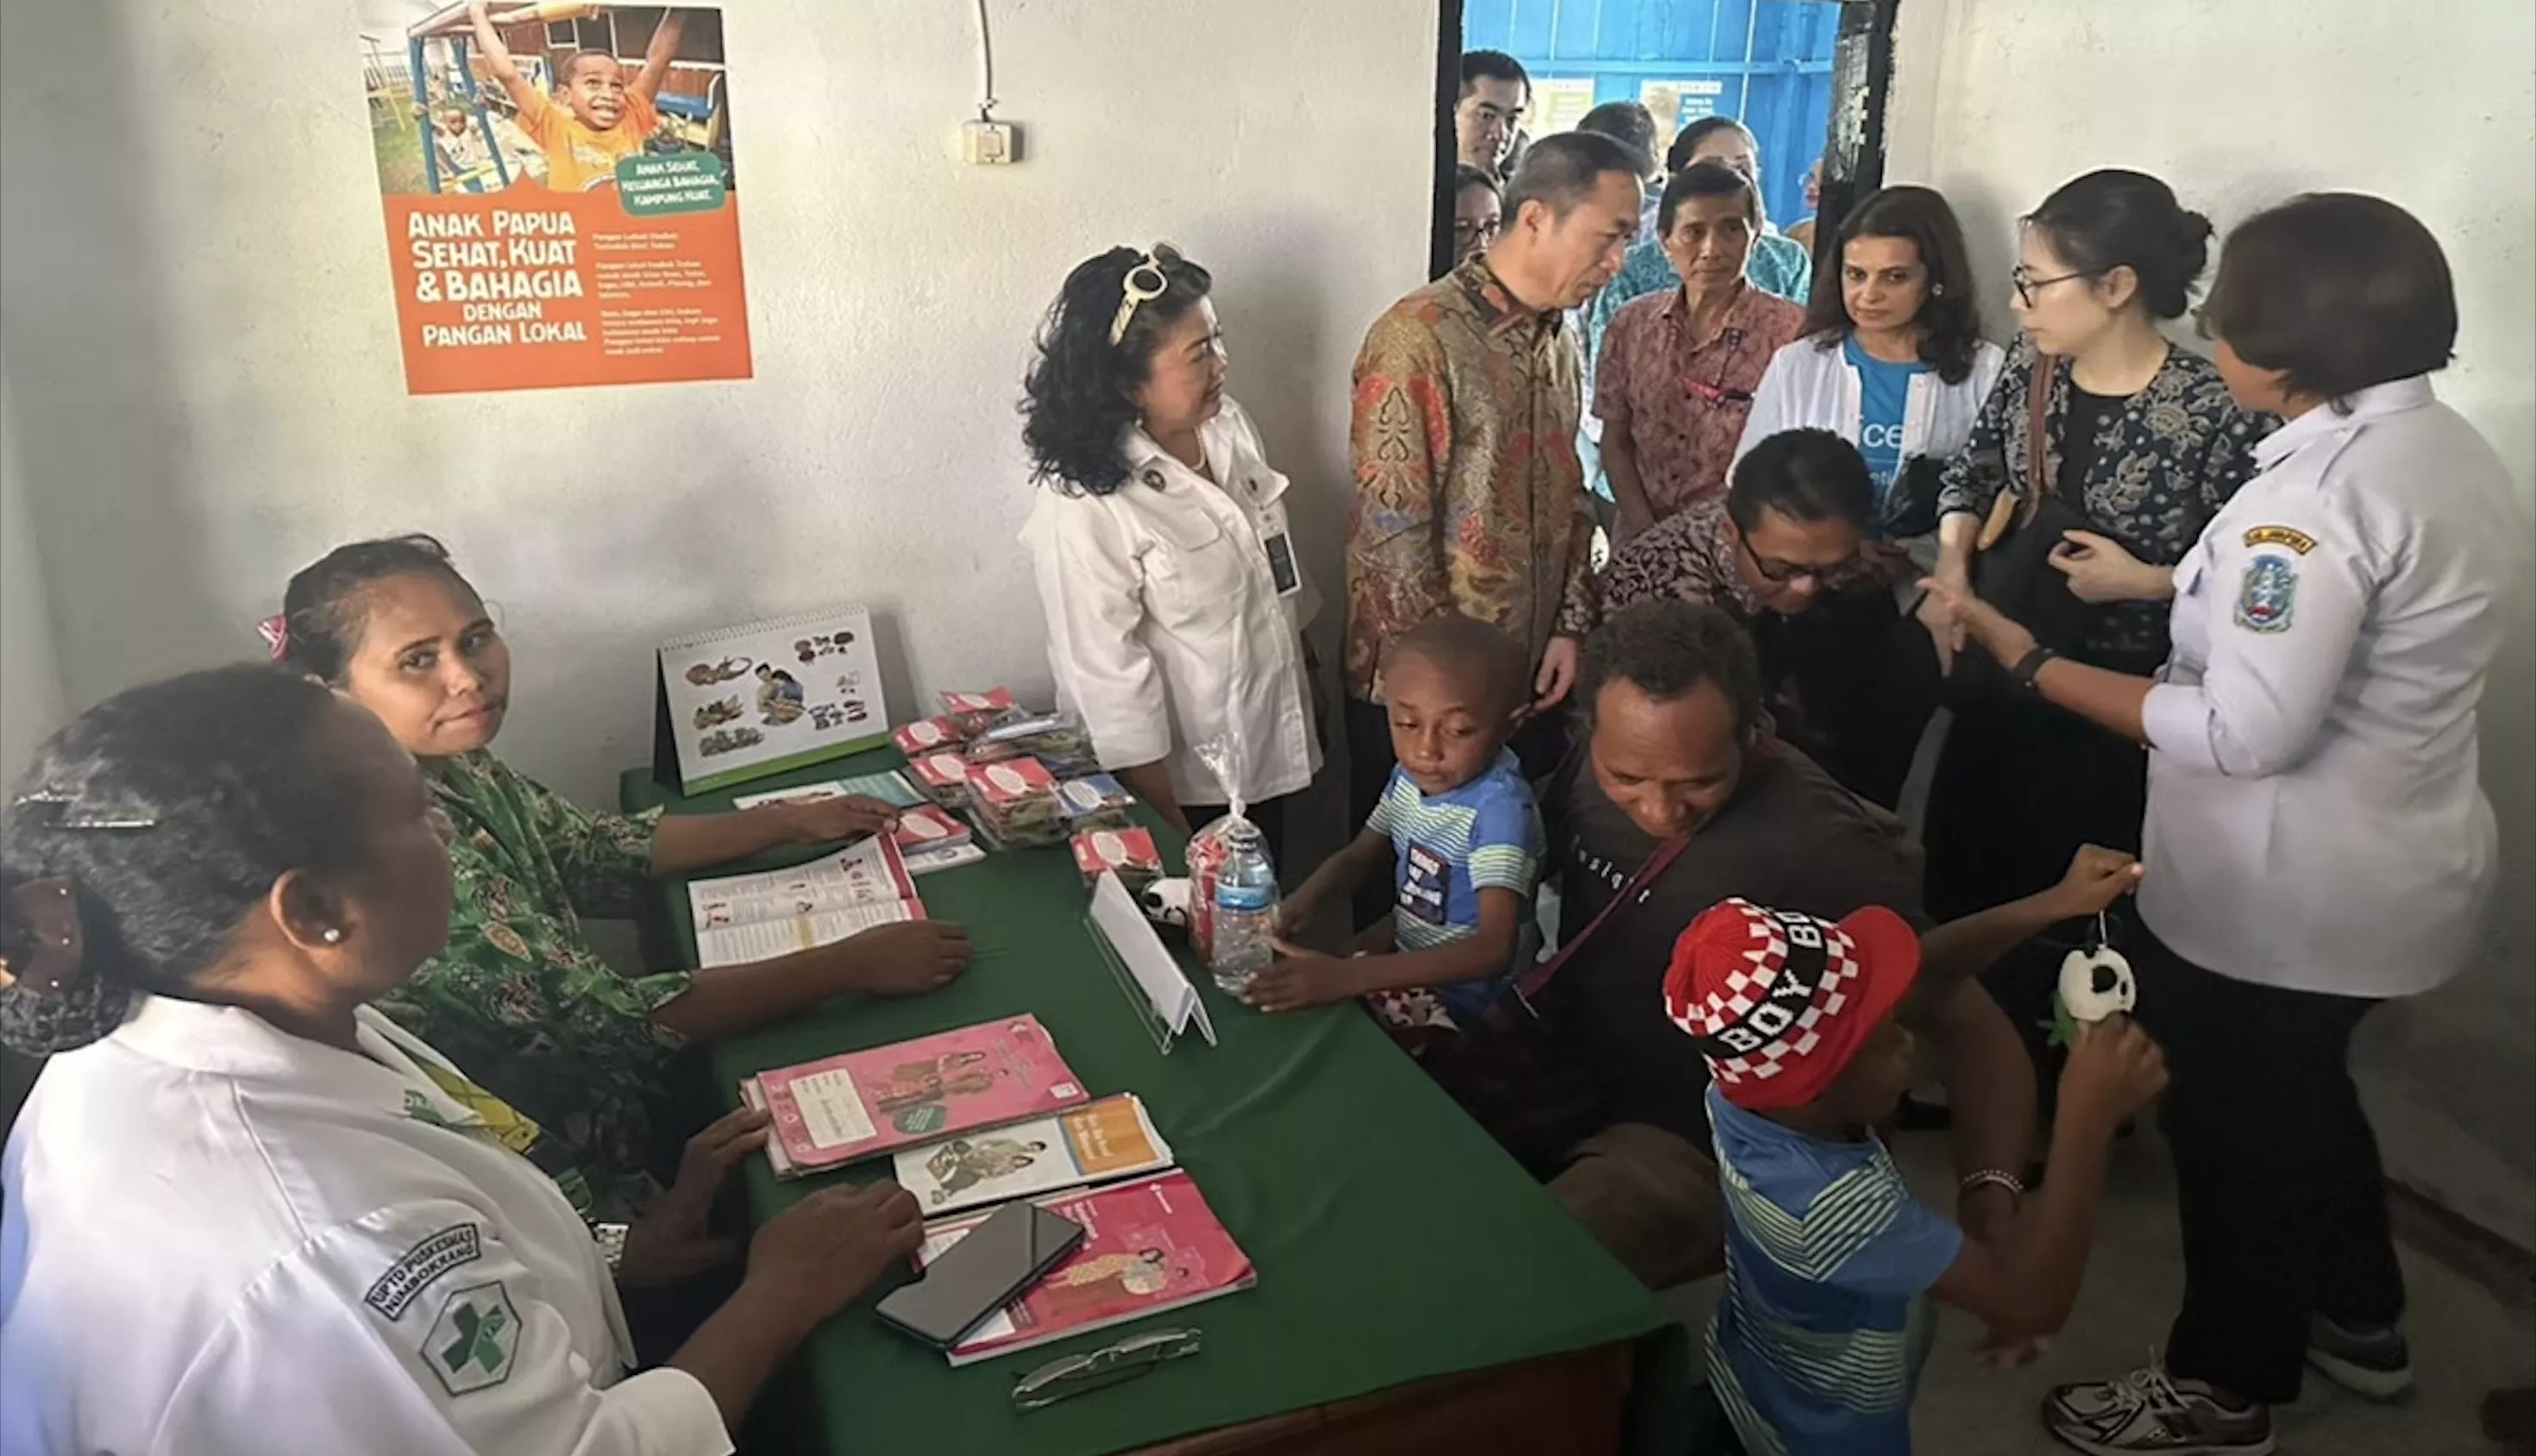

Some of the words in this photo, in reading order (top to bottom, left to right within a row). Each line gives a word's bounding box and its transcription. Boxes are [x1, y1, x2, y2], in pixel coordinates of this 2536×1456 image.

[408, 210, 485, 238] ANAK
[492, 210, 576, 236] PAPUA
[411, 240, 508, 269] SEHAT,
[508, 238, 577, 267] KUAT
[416, 270, 443, 302] &
[444, 269, 584, 301] BAHAGIA
[462, 300, 543, 322] DENGAN
[422, 323, 512, 348] PANGAN
[519, 321, 588, 343] LOKAL
[1859, 414, 1903, 449] ce
[1572, 834, 1651, 904] insigt
[1717, 968, 1812, 1052] BOY
[406, 1229, 474, 1274] PUSKESMAS
